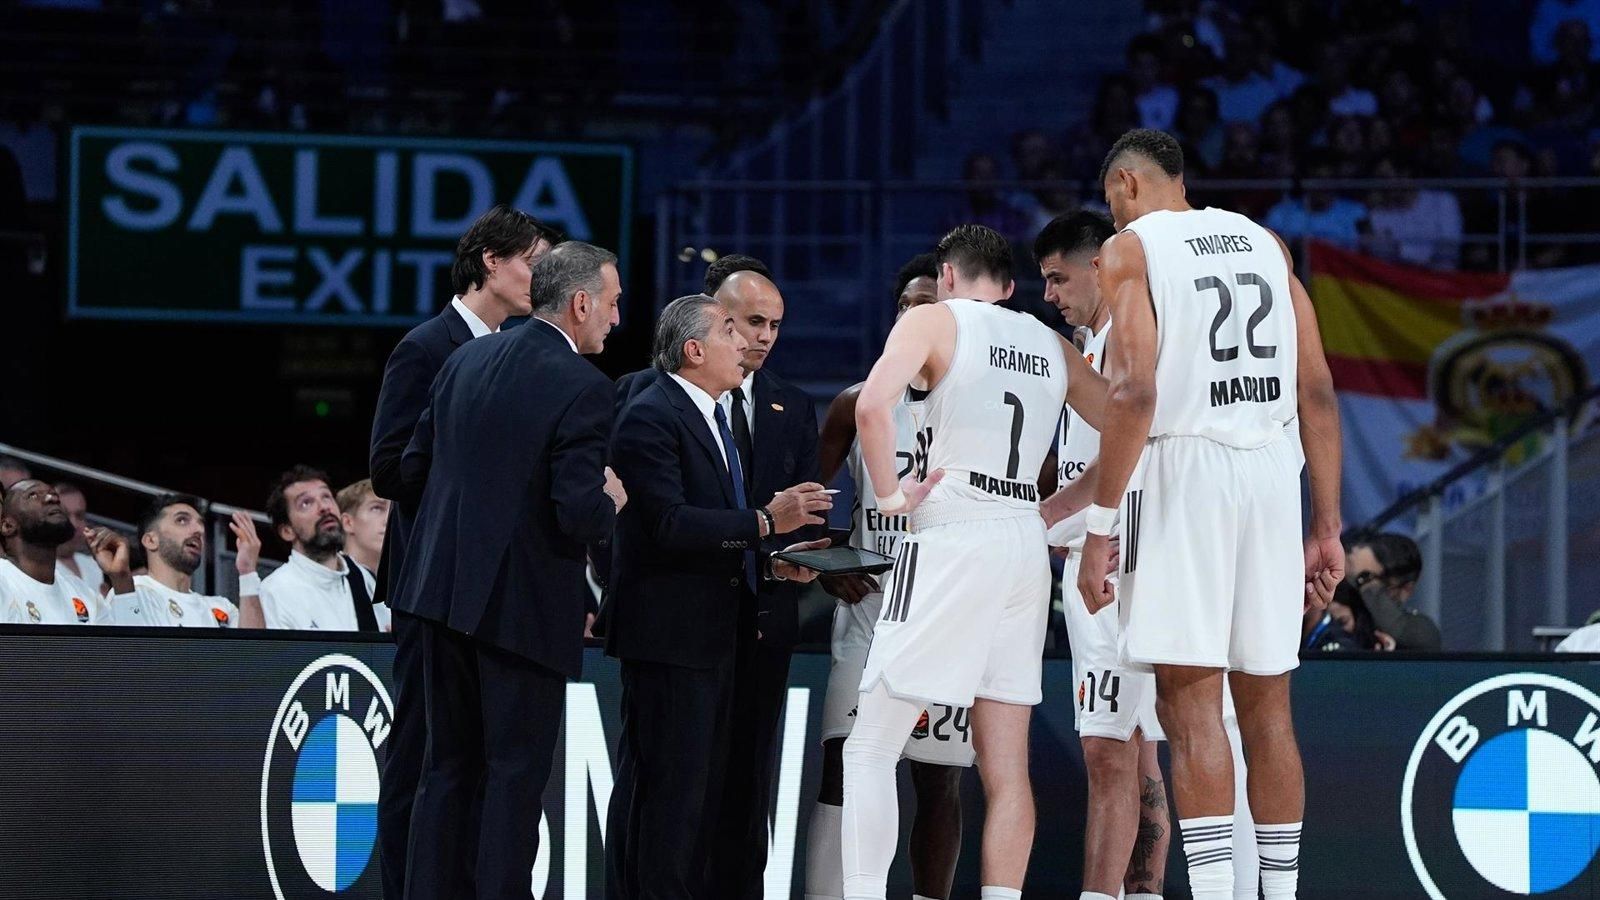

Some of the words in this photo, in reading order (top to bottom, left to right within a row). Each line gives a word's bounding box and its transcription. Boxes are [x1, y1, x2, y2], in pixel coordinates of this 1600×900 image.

[101, 141, 593, 240] SALIDA
[1185, 235, 1253, 256] TAVARES
[240, 245, 456, 313] EXIT
[1194, 273, 1277, 362] 22
[990, 345, 1050, 378] KRÄMER
[1210, 376, 1281, 407] MADRID
[1003, 391, 1024, 479] 1
[281, 672, 392, 752] BMW
[1087, 670, 1120, 712] 14
[932, 703, 970, 742] 24
